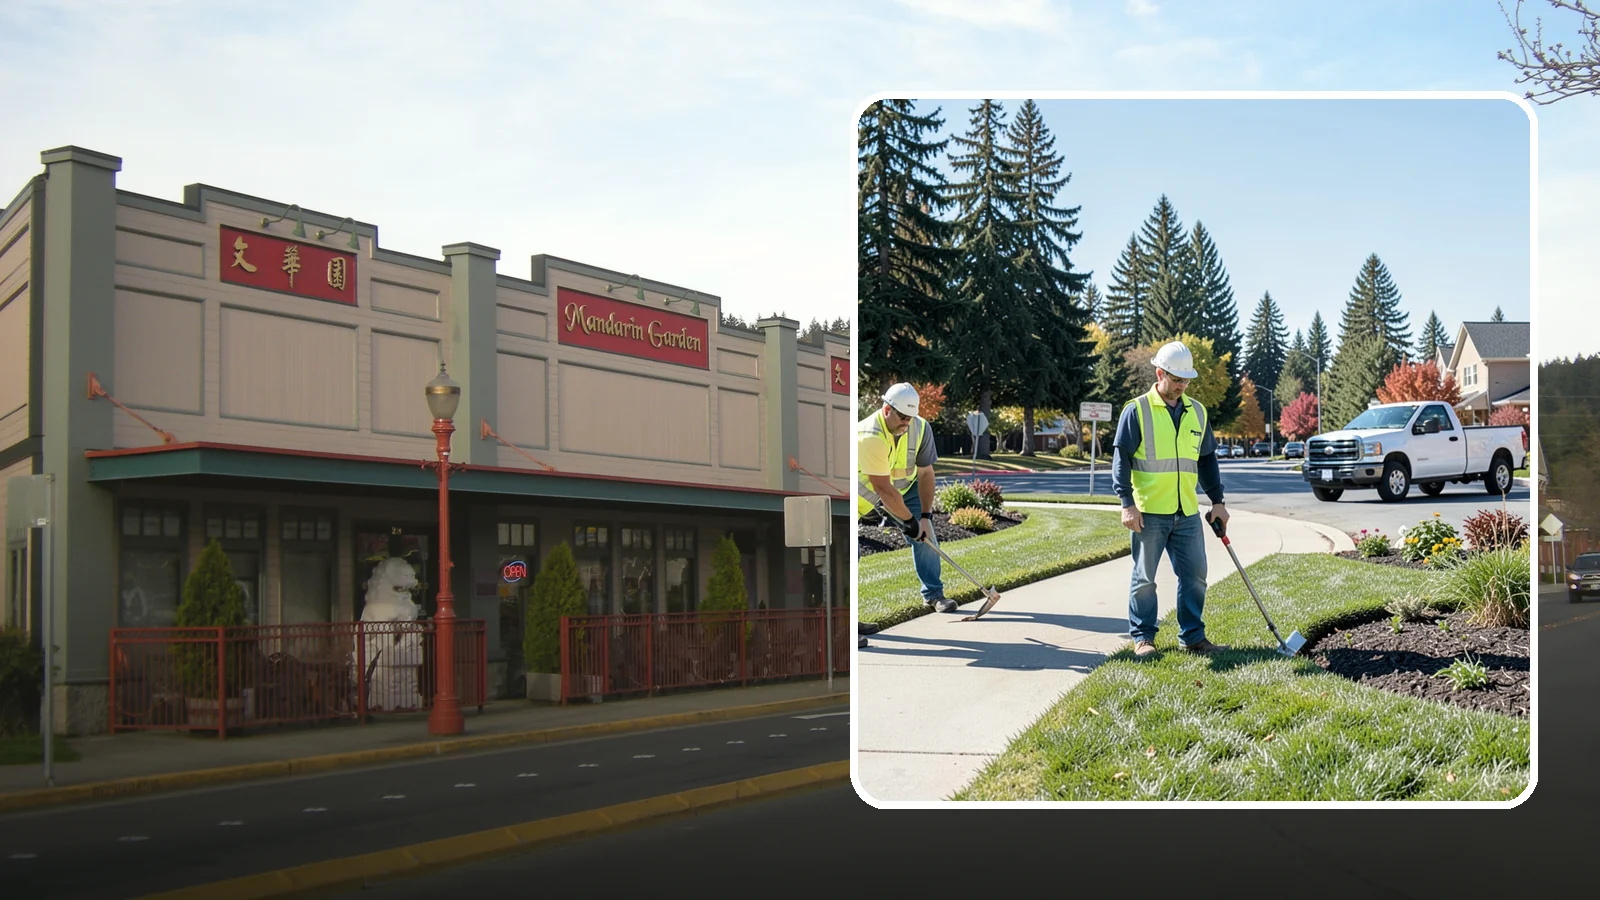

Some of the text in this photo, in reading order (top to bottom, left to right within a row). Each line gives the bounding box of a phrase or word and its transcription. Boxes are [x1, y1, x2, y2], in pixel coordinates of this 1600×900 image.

[231, 235, 346, 291] 文華園
[564, 302, 701, 352] Mandarin Garden
[503, 565, 527, 578] OPEN
